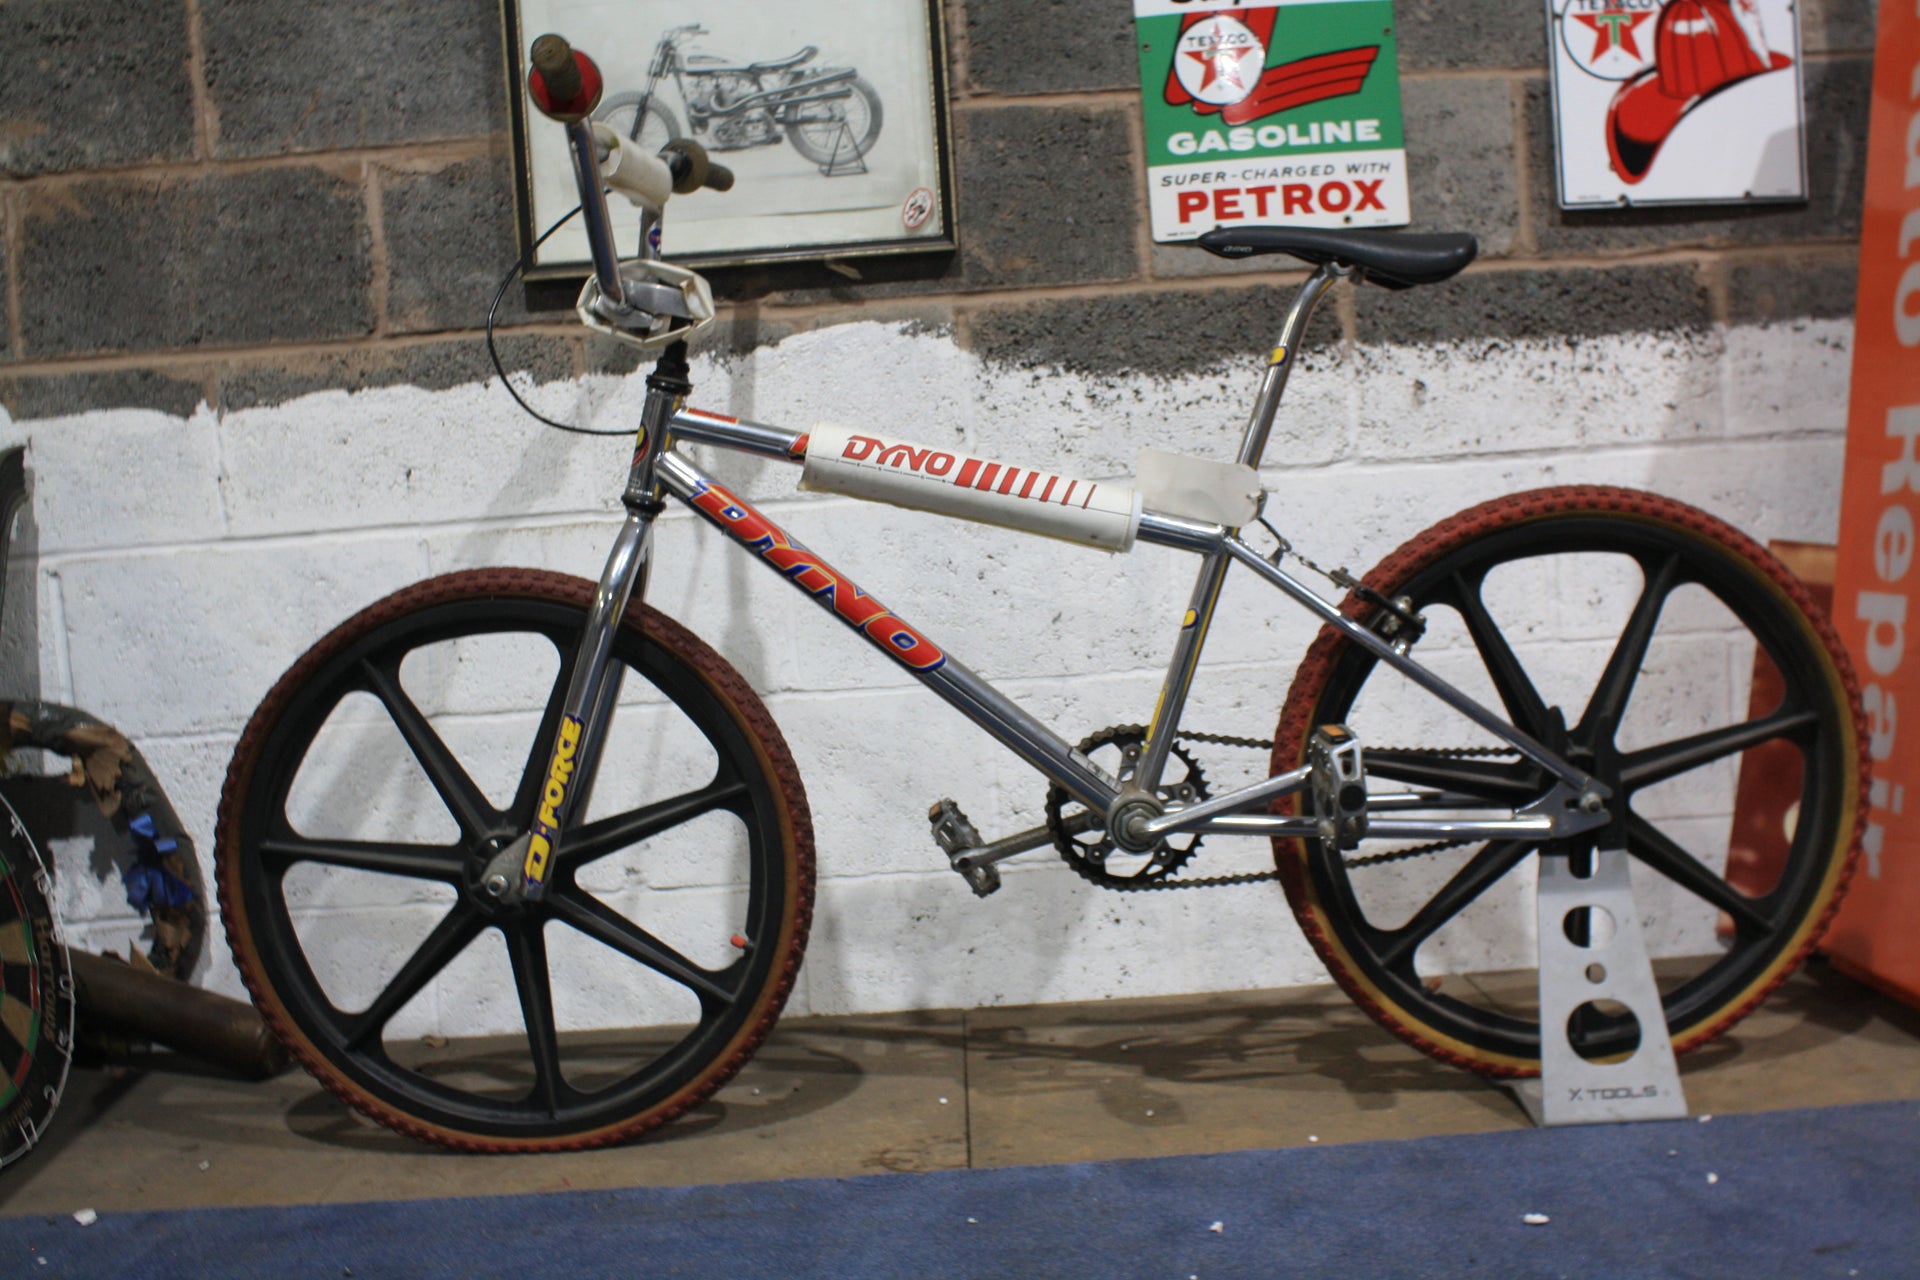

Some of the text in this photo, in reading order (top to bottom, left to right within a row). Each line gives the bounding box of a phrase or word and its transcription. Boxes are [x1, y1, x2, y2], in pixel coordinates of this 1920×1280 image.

[1167, 119, 1381, 155] GASOLINE
[1347, 162, 1391, 174] WITH
[1177, 179, 1386, 224] PETROX
[842, 435, 955, 476] DYNO
[687, 480, 946, 671] DYNO
[1856, 404, 1920, 880] Repair
